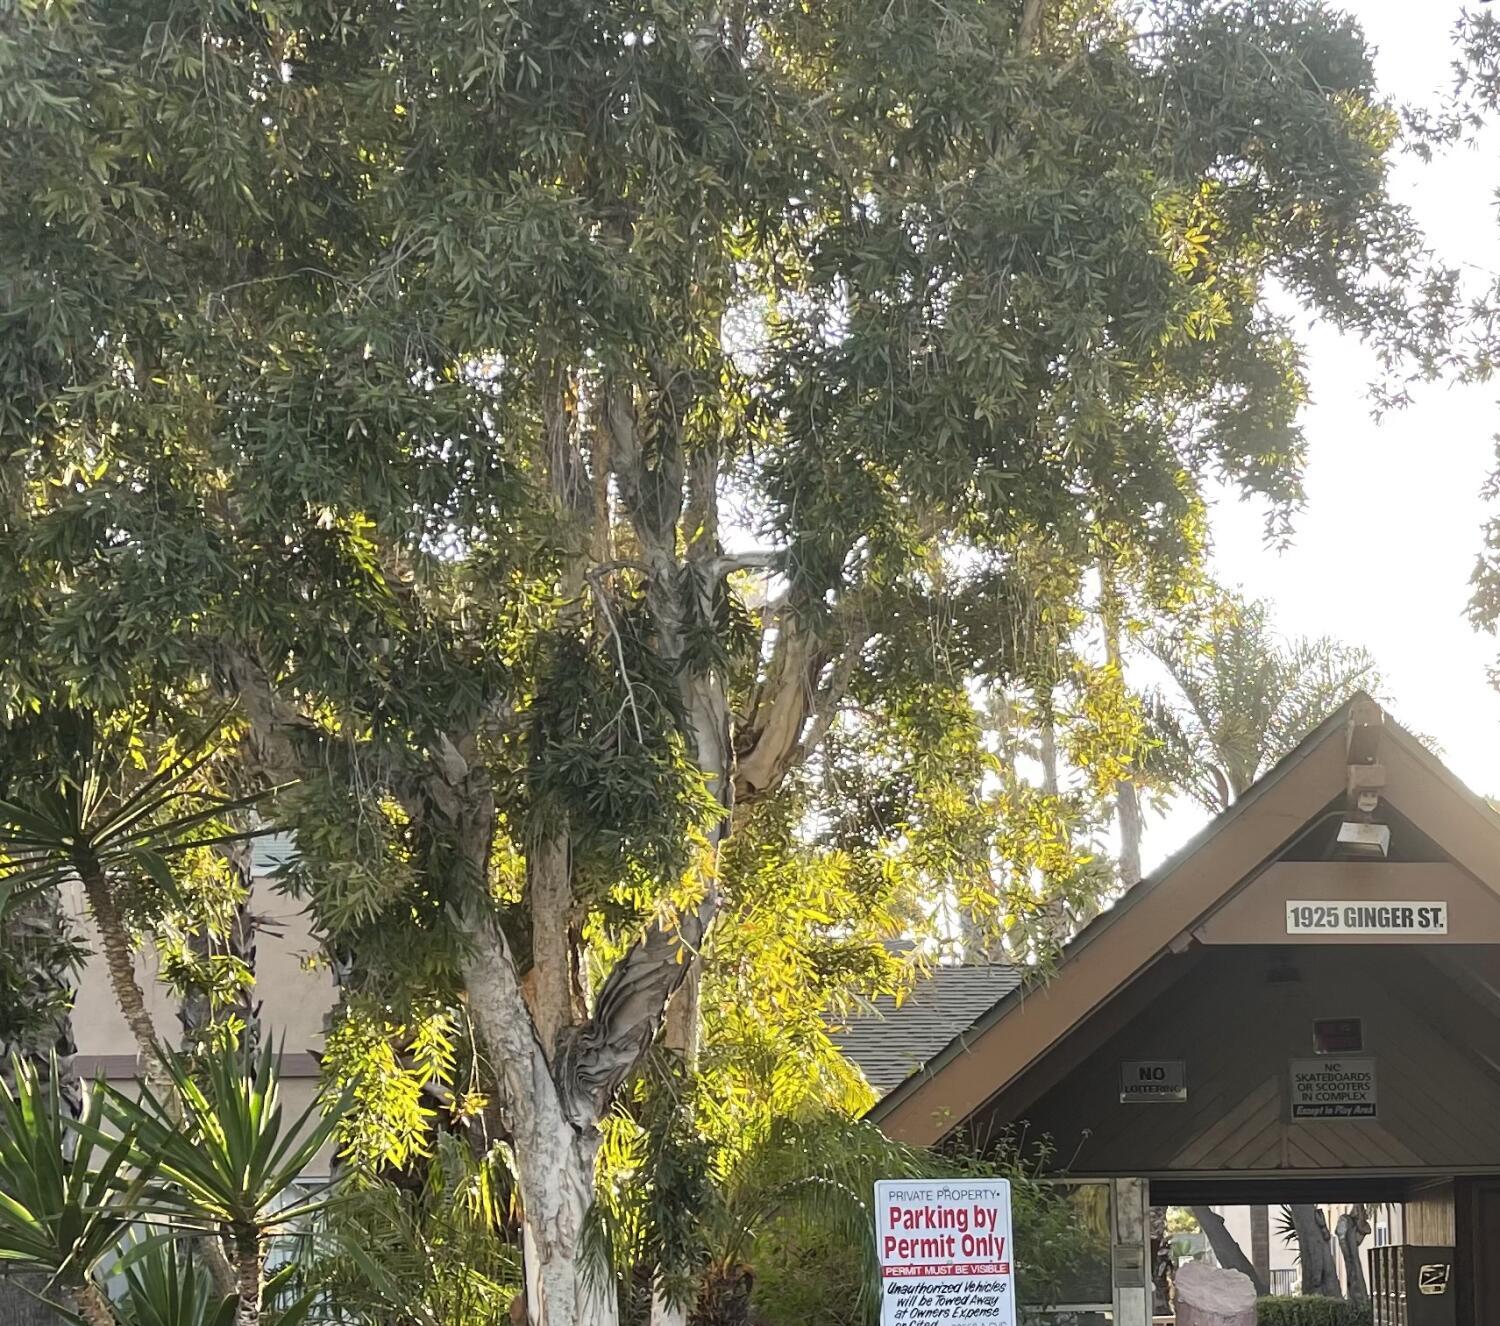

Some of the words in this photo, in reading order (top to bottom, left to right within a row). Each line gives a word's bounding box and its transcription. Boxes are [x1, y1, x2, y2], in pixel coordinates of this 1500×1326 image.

[1290, 906, 1340, 928] 1925
[1343, 906, 1414, 929] GINGER
[1417, 907, 1444, 929] ST.
[1139, 1066, 1166, 1081] NO
[1295, 1072, 1372, 1082] SKATEBOARDS
[1297, 1083, 1313, 1092] OR
[1315, 1082, 1371, 1091] SCOOTERS
[1302, 1093, 1313, 1101] IN
[1315, 1092, 1368, 1101] COMPLEX
[888, 1190, 933, 1201] PRIVATE
[936, 1189, 997, 1201] PROPERTY
[889, 1205, 968, 1233] Parking
[973, 1204, 998, 1232] by
[884, 1234, 956, 1259] Permit
[961, 1233, 1006, 1261] Only
[885, 1265, 922, 1276] PERMIT
[925, 1265, 953, 1275] MUST
[955, 1264, 969, 1274] BE
[970, 1263, 1008, 1274] VISIBLE
[887, 1281, 962, 1295] Unauthorized
[963, 1280, 1007, 1293] Vehicles
[896, 1295, 918, 1307] will
[918, 1295, 933, 1306] be
[934, 1294, 970, 1306] Towed
[968, 1294, 1000, 1307] Away
[894, 1307, 909, 1319] at
[909, 1307, 951, 1319] Owners
[951, 1306, 1000, 1320] Expense
